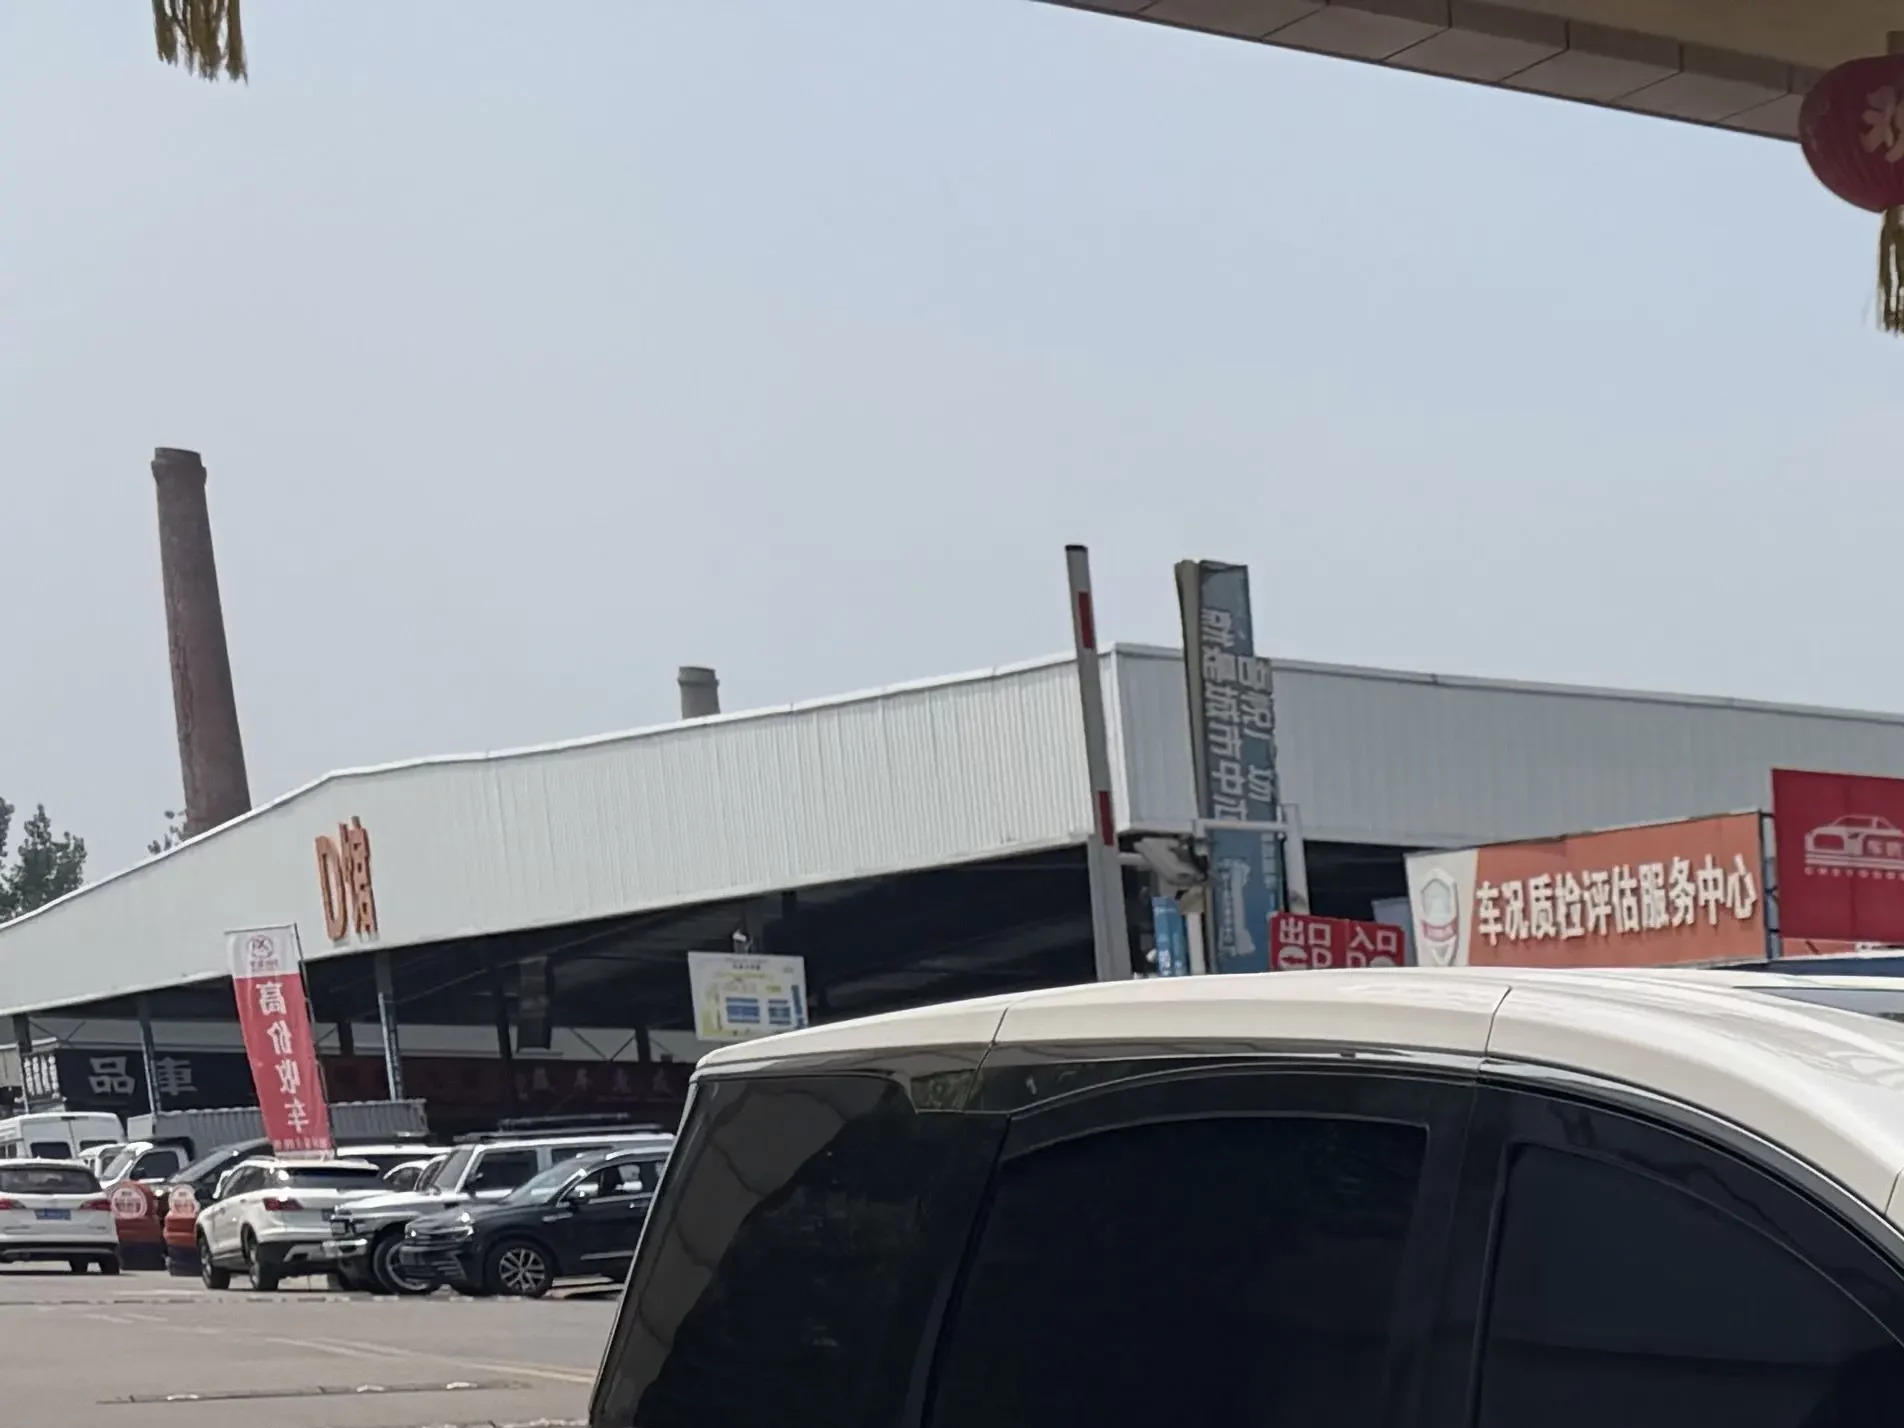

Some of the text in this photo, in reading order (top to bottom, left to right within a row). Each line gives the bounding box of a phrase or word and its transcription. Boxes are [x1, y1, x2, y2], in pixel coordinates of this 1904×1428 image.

[1475, 853, 1757, 947] 车况质检评估服务中心
[1279, 917, 1332, 946] 出口
[1350, 924, 1398, 953] 入口
